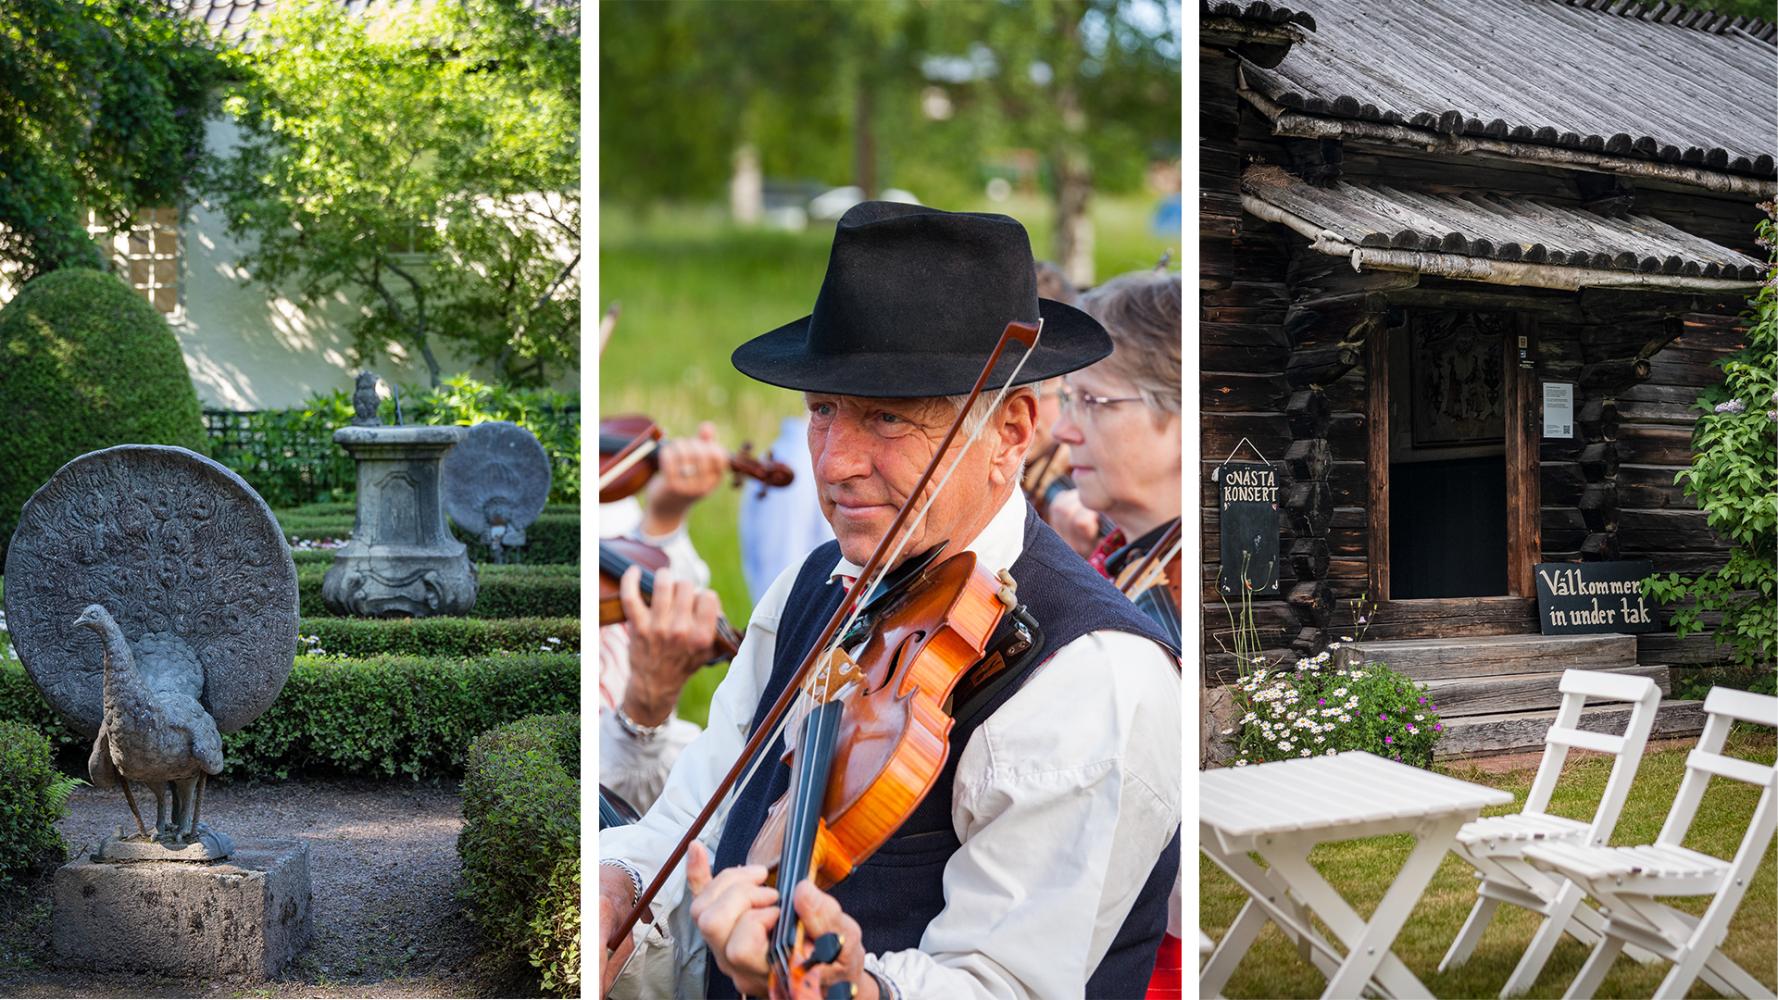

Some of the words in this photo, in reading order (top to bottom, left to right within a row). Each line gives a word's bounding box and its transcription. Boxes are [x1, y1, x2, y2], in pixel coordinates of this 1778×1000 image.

[1226, 467, 1275, 486] NÄSTA
[1224, 486, 1279, 502] KONSERT
[1549, 606, 1567, 626] in
[1570, 597, 1616, 625] under
[1621, 597, 1651, 624] tak
